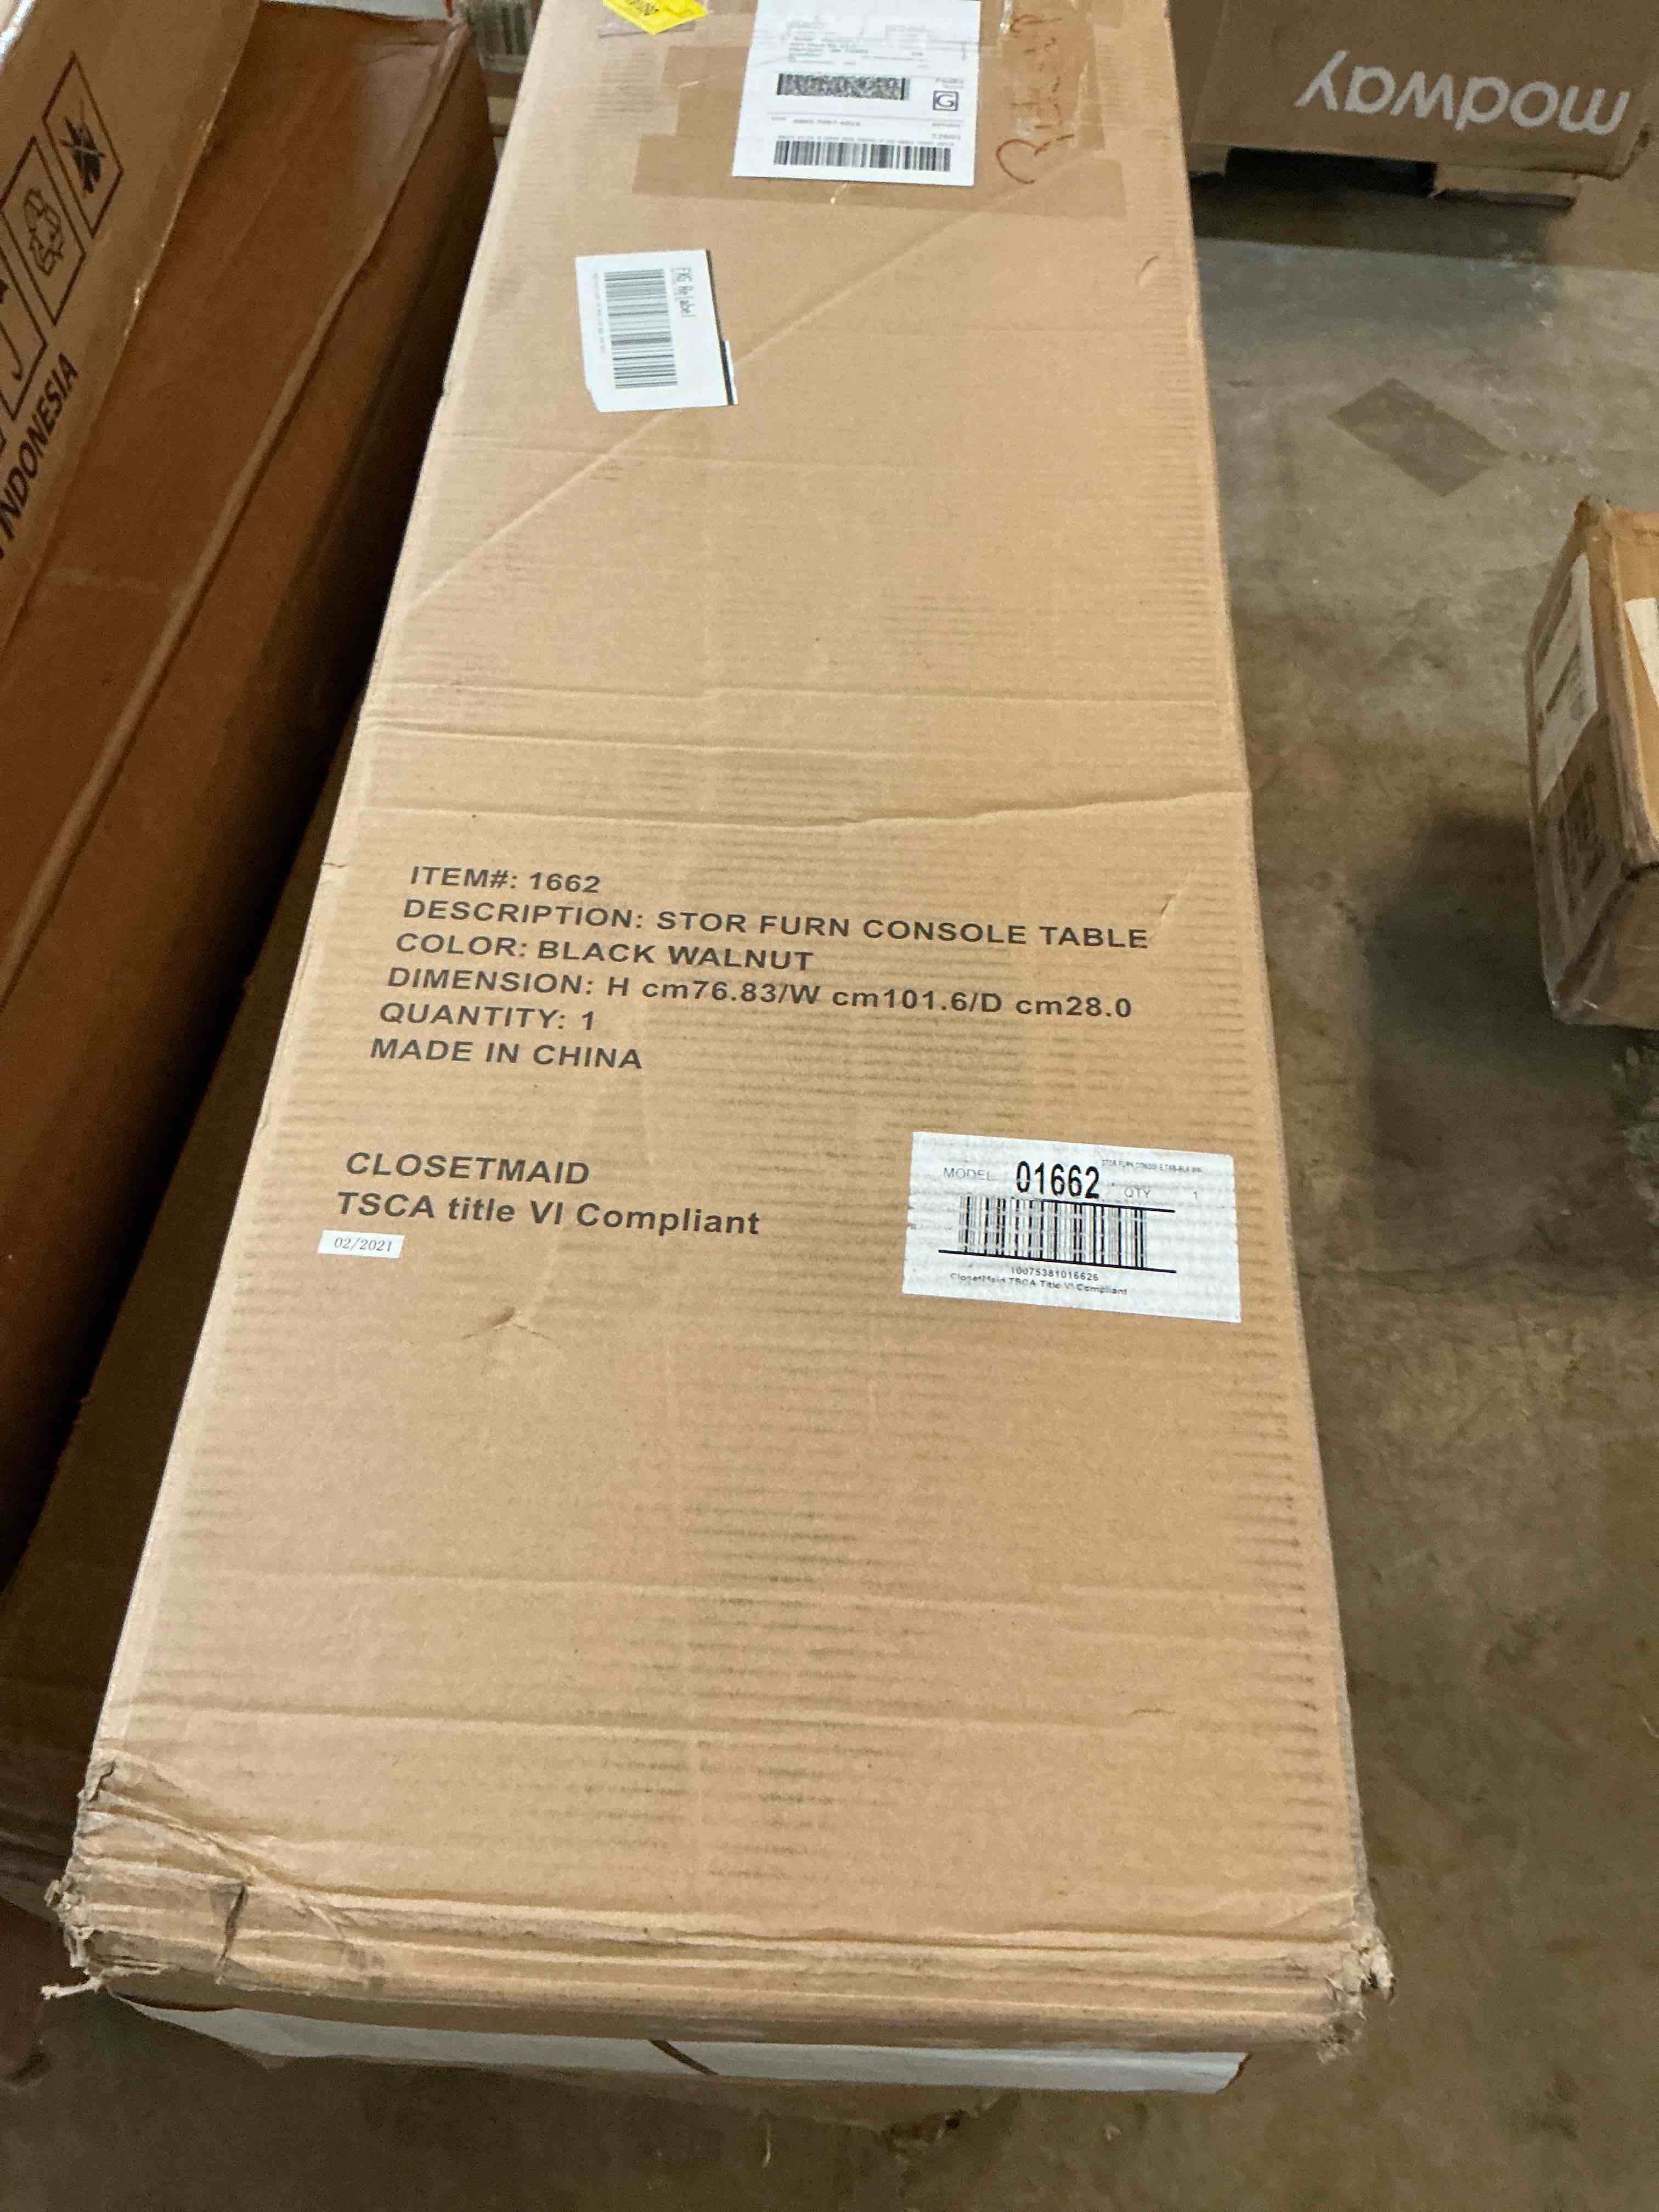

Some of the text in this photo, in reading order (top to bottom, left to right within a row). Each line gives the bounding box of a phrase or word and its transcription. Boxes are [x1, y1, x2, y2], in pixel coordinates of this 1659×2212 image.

[1295, 50, 1630, 136] modway
[0, 352, 78, 560] NDONESIA
[411, 866, 600, 893] ITEM#: 1662
[404, 899, 1148, 949] DESCRIPTION: STOR FURN CONSOLE TABLE
[397, 933, 814, 971] COLOR: BLACK WALNUT
[388, 967, 1131, 1018] DIMENSION: H cm76.83/W cm101.6/D cm28.0
[380, 1002, 593, 1030] QUANTITY: 1
[371, 1039, 642, 1069] MADE IN CHINA
[347, 1152, 589, 1184] CLOSETMAID
[943, 1161, 1099, 1199] MODEL 01662
[1124, 1187, 1198, 1200] QTY 1
[338, 1192, 760, 1237] TSCA title VI Compliant
[334, 1237, 392, 1251] 02/2021
[1008, 1277, 1036, 1286] TSCA
[1011, 1266, 1098, 1281] 10075381016626
